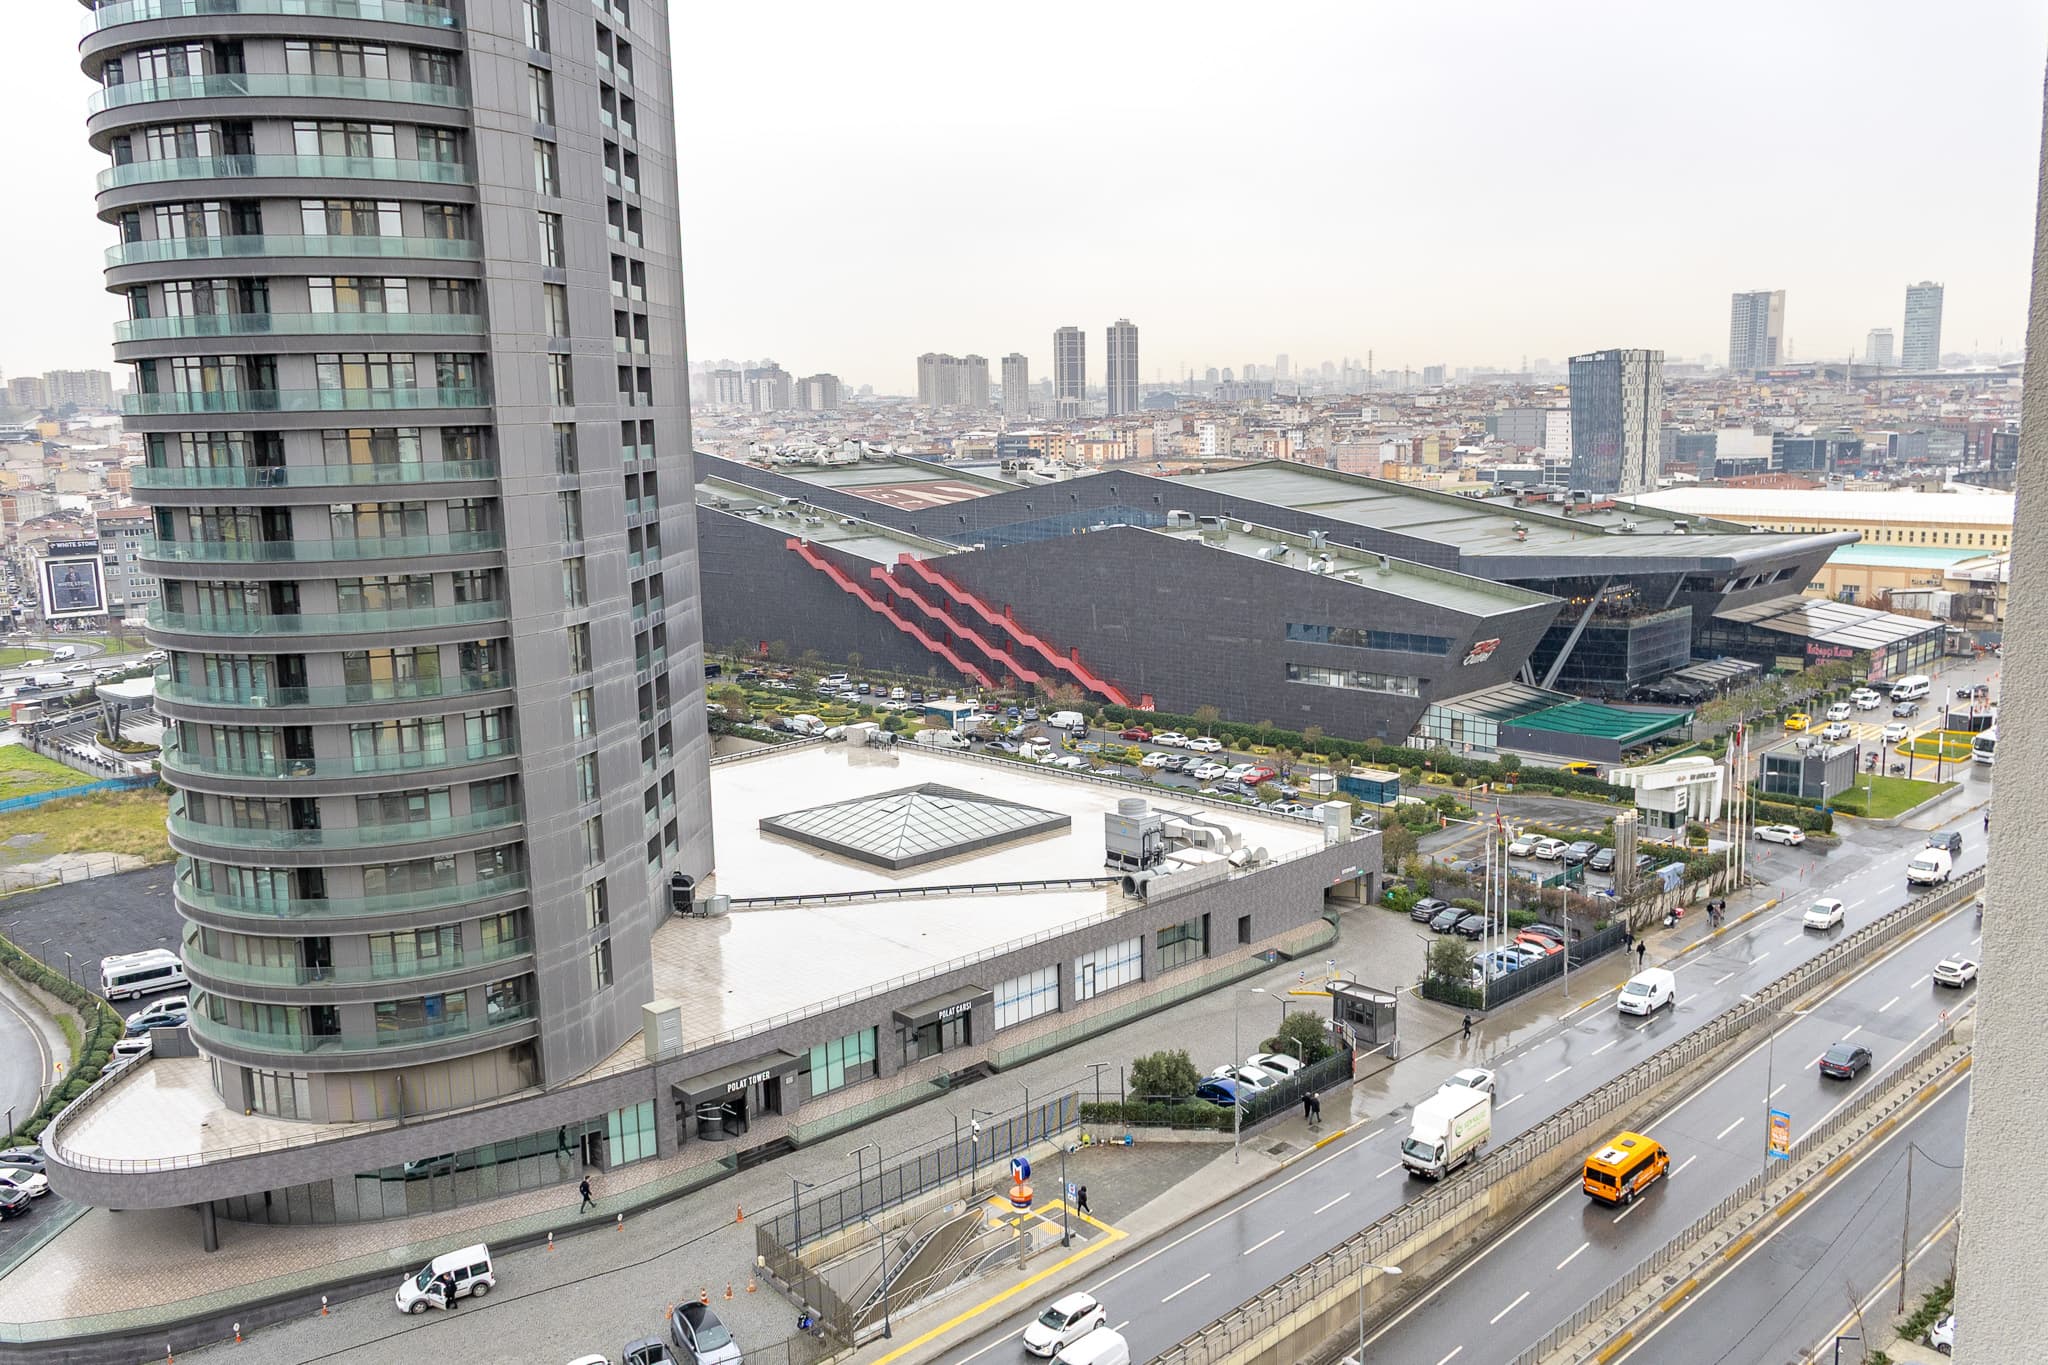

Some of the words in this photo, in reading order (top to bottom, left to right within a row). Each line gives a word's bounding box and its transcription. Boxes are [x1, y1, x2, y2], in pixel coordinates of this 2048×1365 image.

[938, 1006, 955, 1020] POLAT
[727, 1078, 748, 1093] POLAT
[748, 1070, 771, 1086] TOWER
[1012, 1160, 1023, 1181] M
